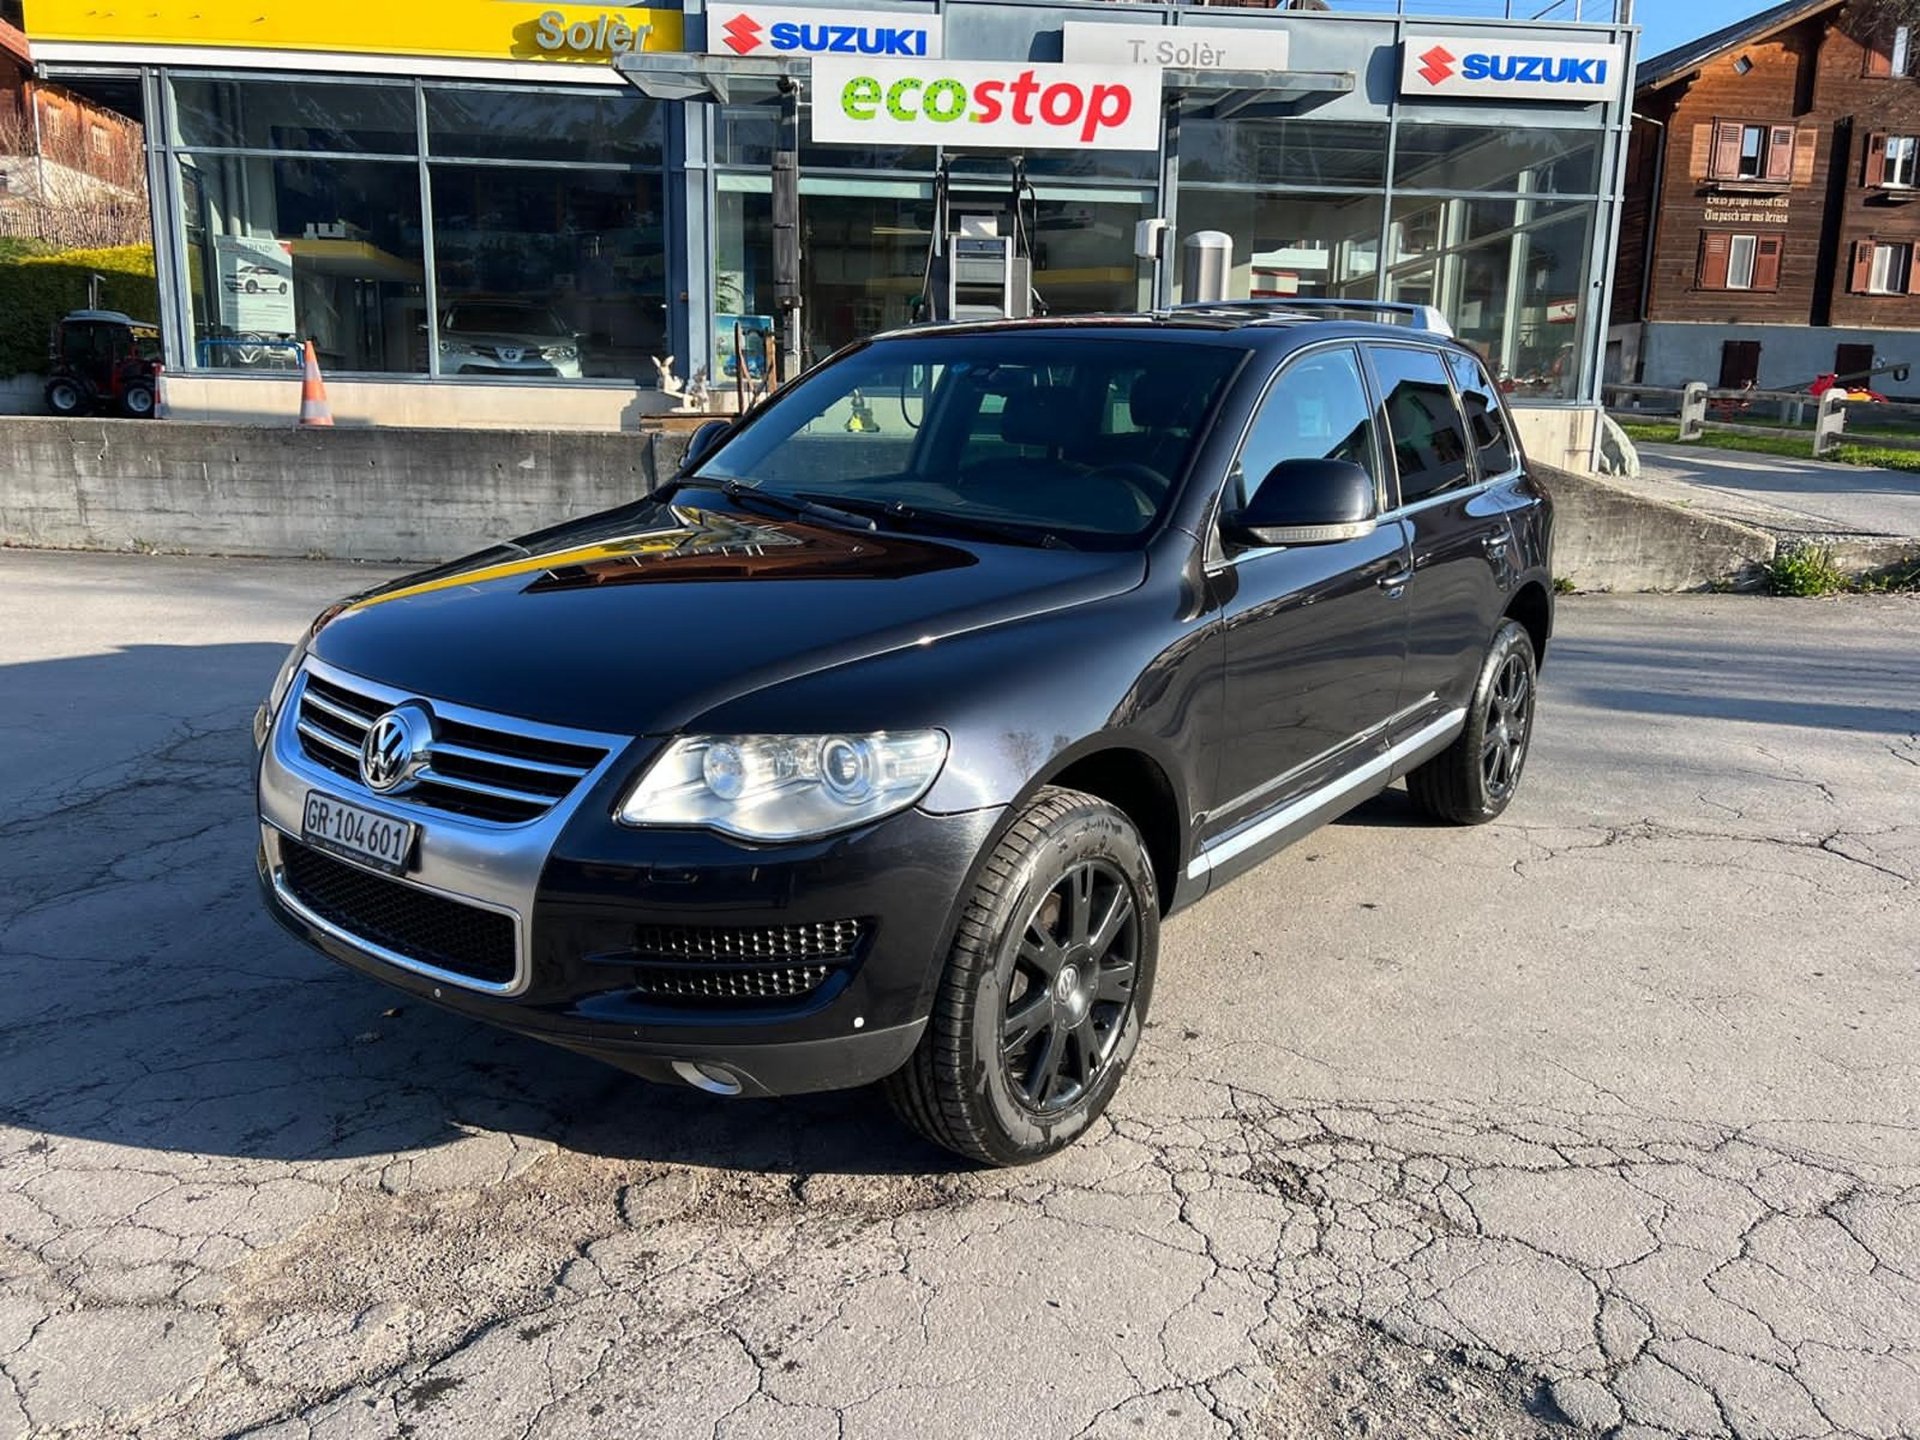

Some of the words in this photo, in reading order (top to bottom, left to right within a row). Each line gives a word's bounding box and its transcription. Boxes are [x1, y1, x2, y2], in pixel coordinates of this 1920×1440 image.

[536, 10, 653, 54] Solèr
[770, 22, 927, 56] SUZUKI
[1127, 40, 1148, 64] T.
[1157, 39, 1226, 67] Solèr
[1462, 53, 1607, 84] SUZUKI
[841, 70, 1132, 142] ecostop
[361, 713, 412, 792] VW
